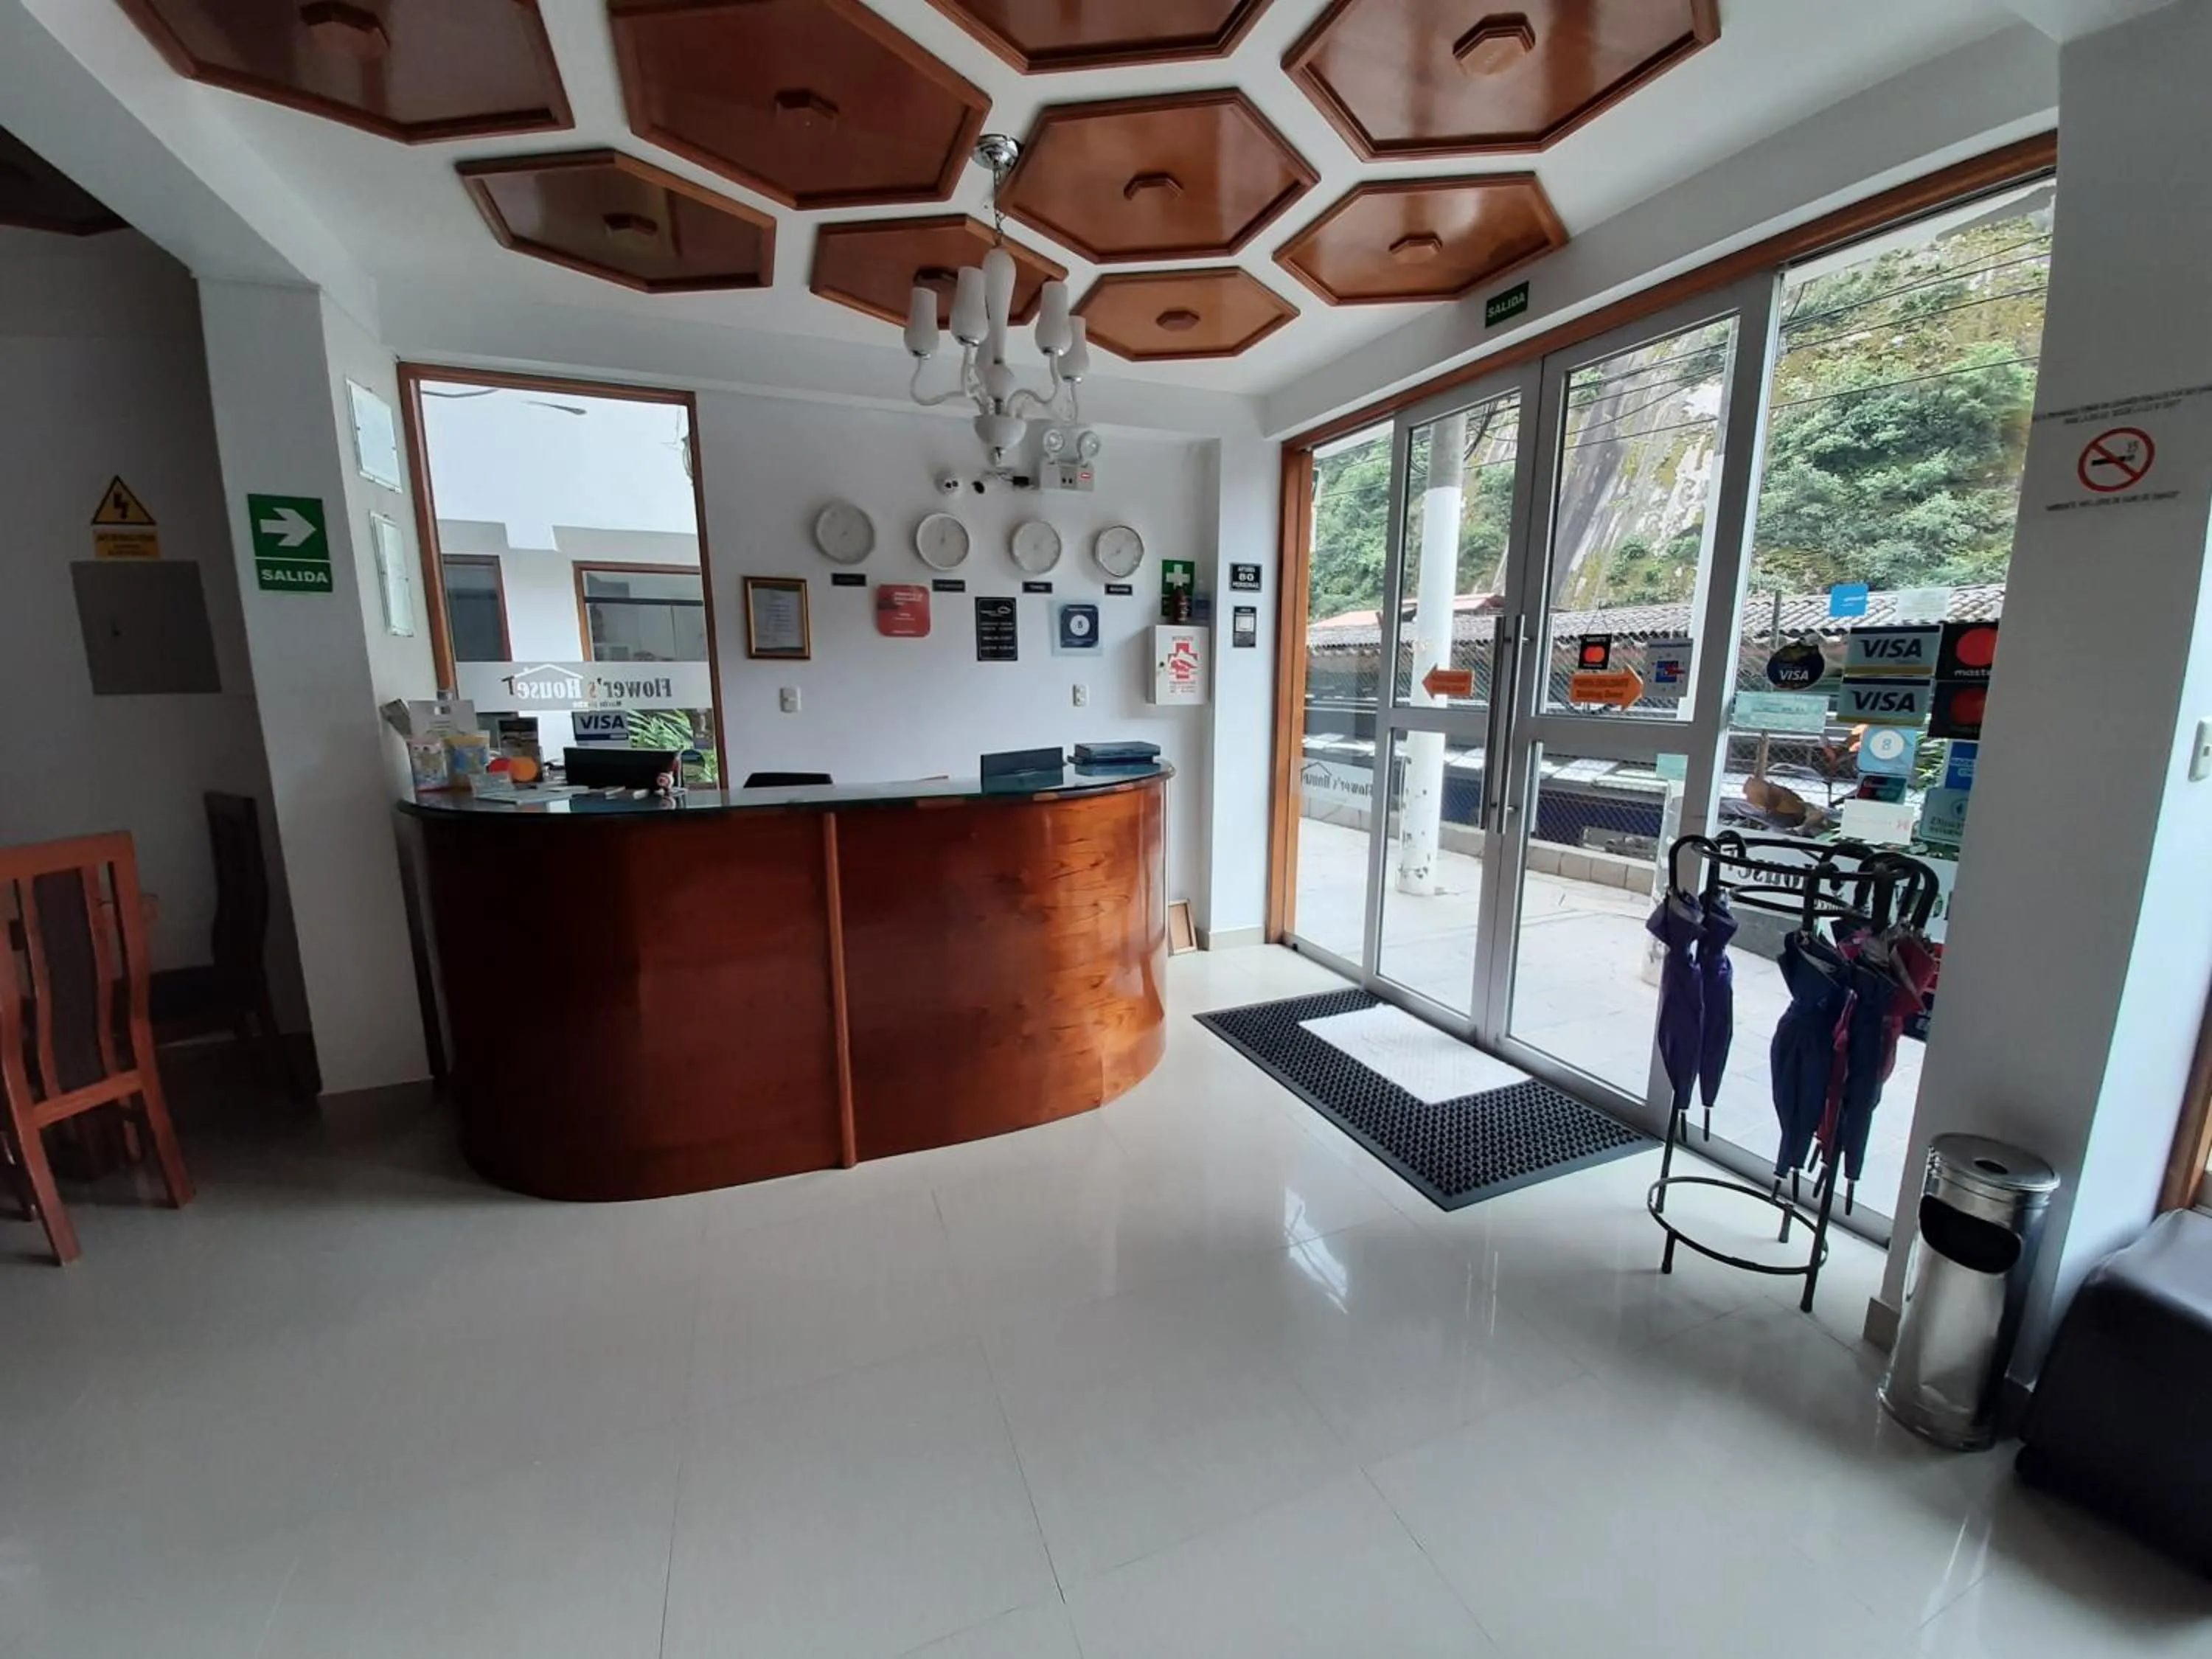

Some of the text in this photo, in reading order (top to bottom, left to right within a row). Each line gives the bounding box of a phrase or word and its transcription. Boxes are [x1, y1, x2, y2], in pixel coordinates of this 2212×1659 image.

[1487, 291, 1526, 318] SALIDA
[261, 568, 329, 585] SALIDA
[1860, 638, 1922, 658] VISA
[1778, 669, 1809, 681] VISA
[1851, 690, 1916, 712] VISA
[580, 714, 625, 730] VISA
